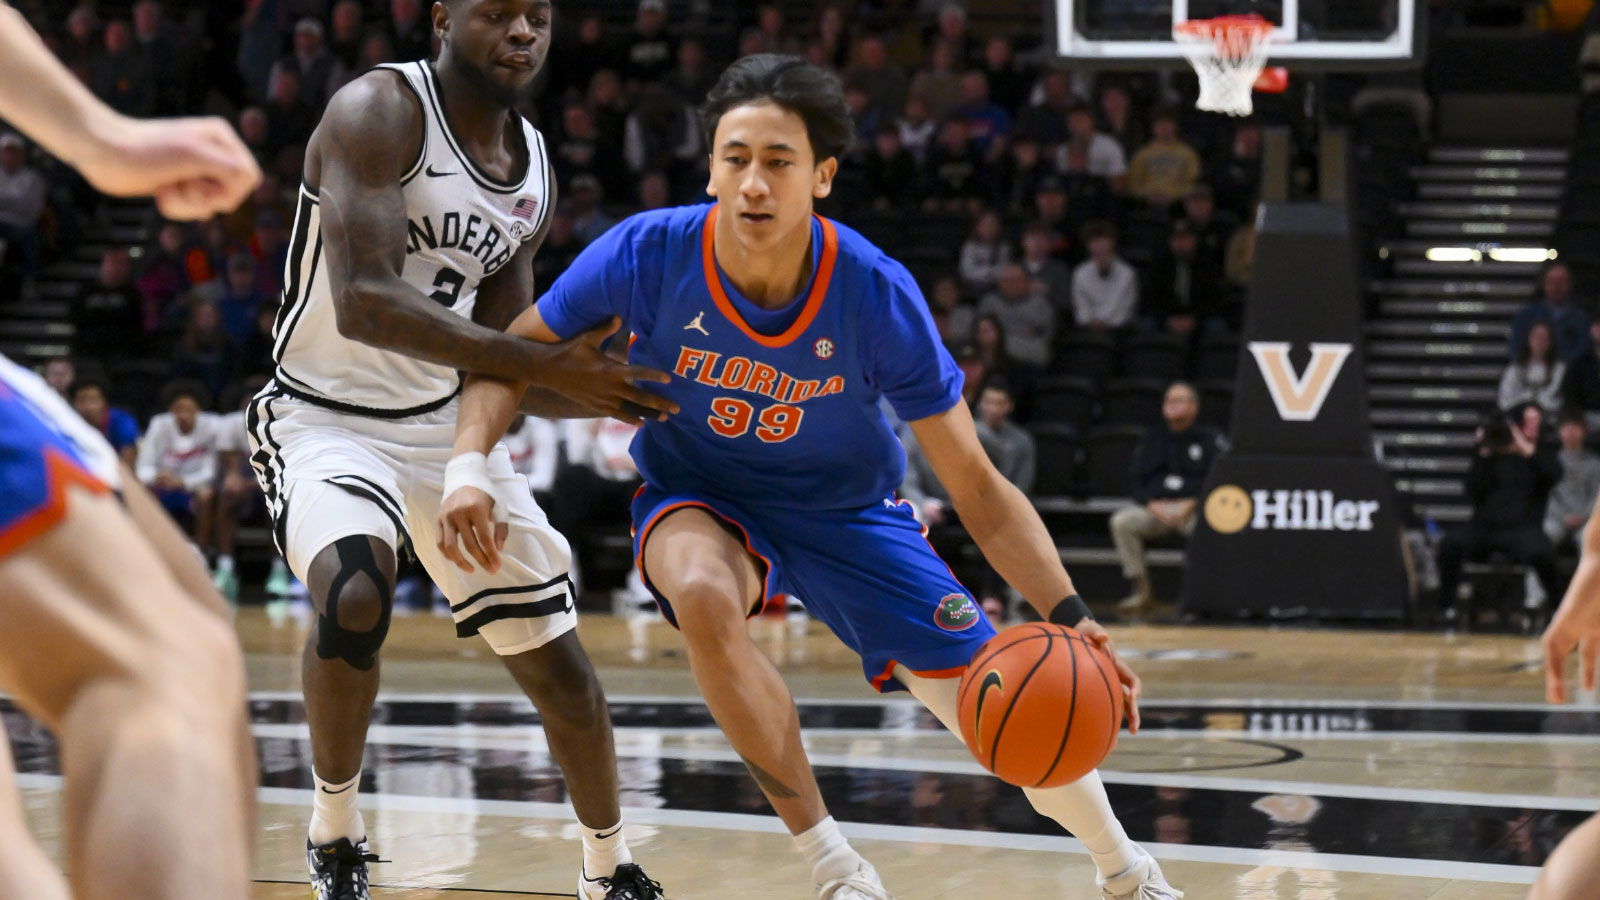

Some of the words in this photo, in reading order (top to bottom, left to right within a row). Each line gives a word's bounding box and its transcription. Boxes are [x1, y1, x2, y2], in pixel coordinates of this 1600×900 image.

[406, 212, 511, 275] NDERB
[815, 339, 833, 357] SEC
[673, 345, 844, 404] FLORIDA
[1248, 341, 1352, 421] V
[707, 397, 804, 443] 99
[1252, 489, 1379, 531] Hiller
